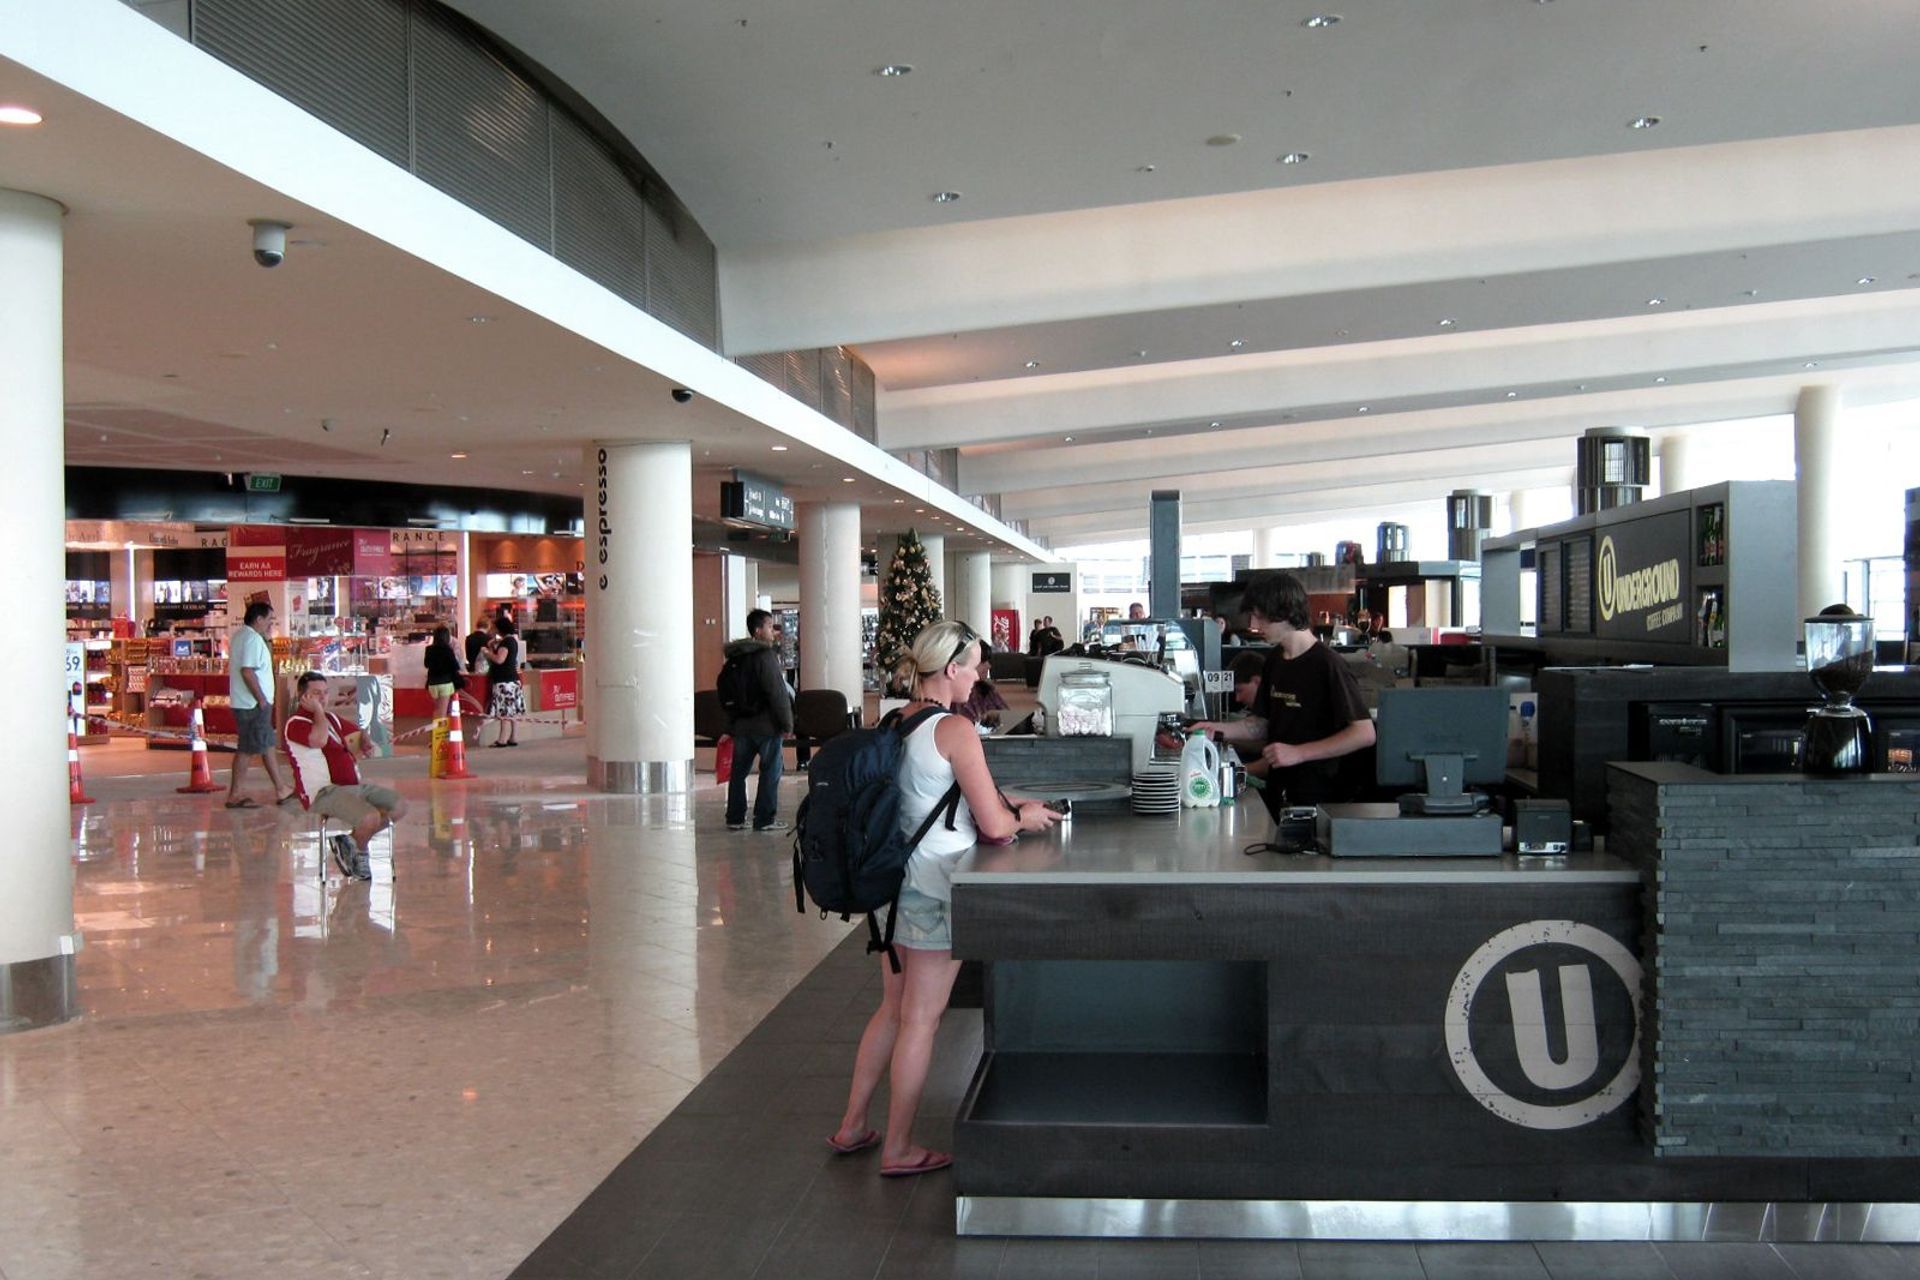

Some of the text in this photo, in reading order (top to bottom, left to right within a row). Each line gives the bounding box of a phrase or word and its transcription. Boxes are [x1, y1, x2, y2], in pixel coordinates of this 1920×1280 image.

[255, 478, 274, 488] EXIT
[598, 448, 612, 565] espresso
[392, 531, 446, 542] RANCE
[289, 538, 351, 567] Fragrance
[239, 561, 272, 570] EARN AA
[228, 569, 283, 578] REWARDS HERE
[1616, 559, 1679, 613] UNDERGROUND
[1207, 672, 1220, 682] 09
[1223, 672, 1233, 682] 21
